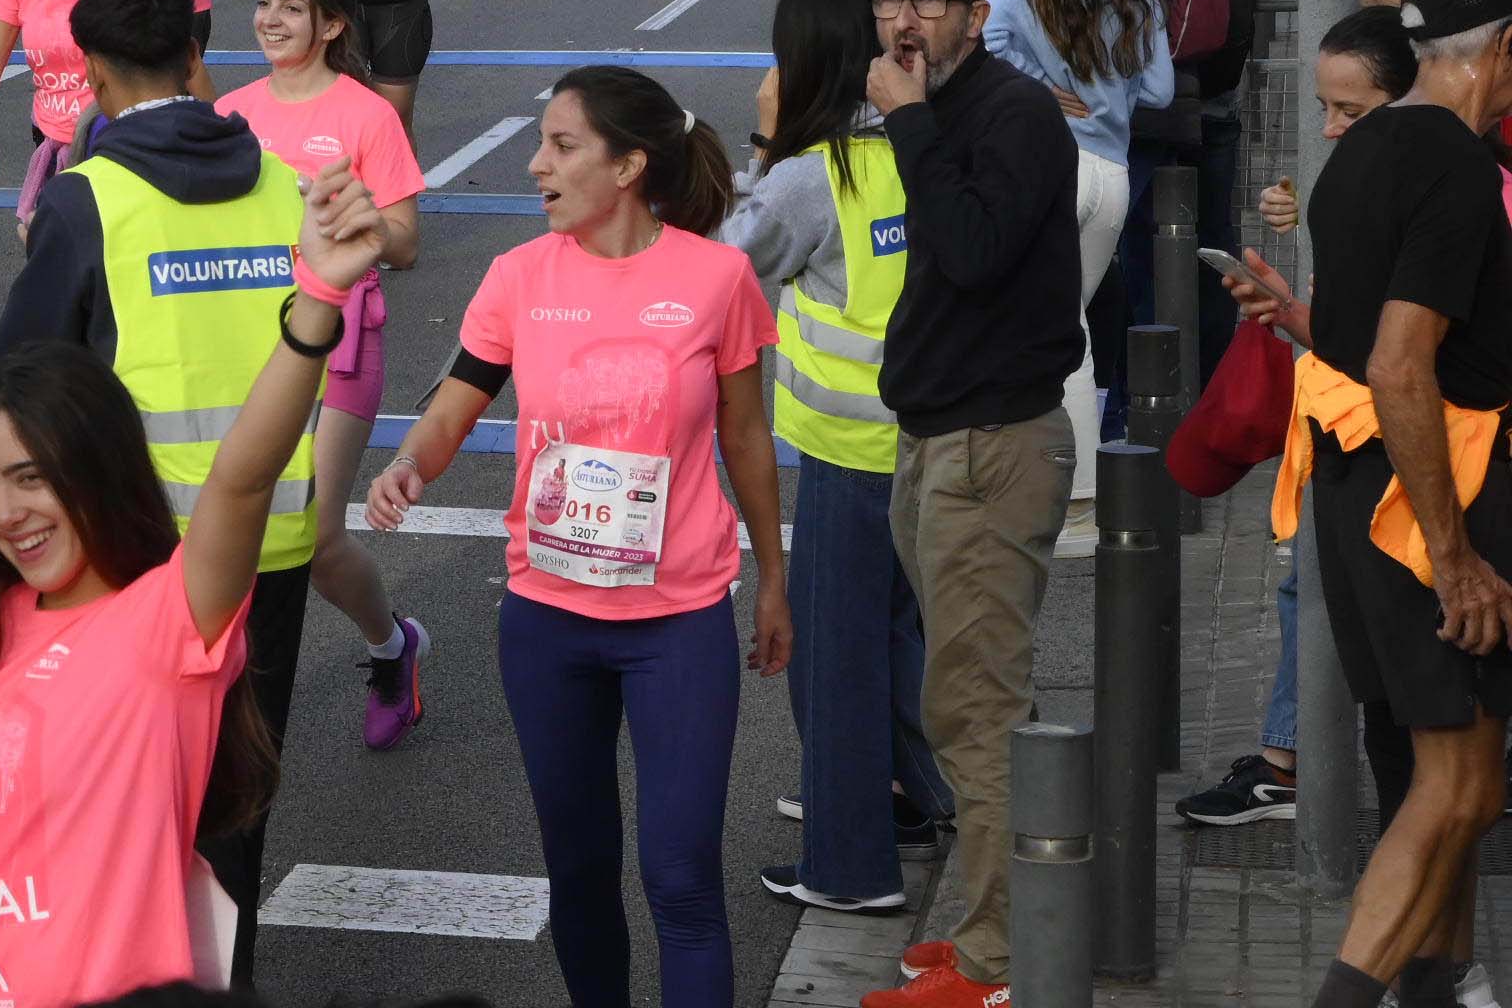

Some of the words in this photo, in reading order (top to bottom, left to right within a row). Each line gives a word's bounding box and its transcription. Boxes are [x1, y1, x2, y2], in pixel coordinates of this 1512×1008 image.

[153, 256, 289, 285] VOLUNTARIS
[530, 307, 591, 322] OYSHO
[576, 471, 617, 487] ASTURIANA
[629, 472, 657, 483] SUMA
[566, 499, 612, 524] 016
[570, 526, 598, 541] 3207
[539, 535, 568, 550] CARRERA
[569, 543, 579, 552] DE
[580, 545, 590, 554] LA
[591, 547, 621, 559] MUJER
[624, 551, 644, 561] 2023
[536, 552, 570, 570] OYSHO
